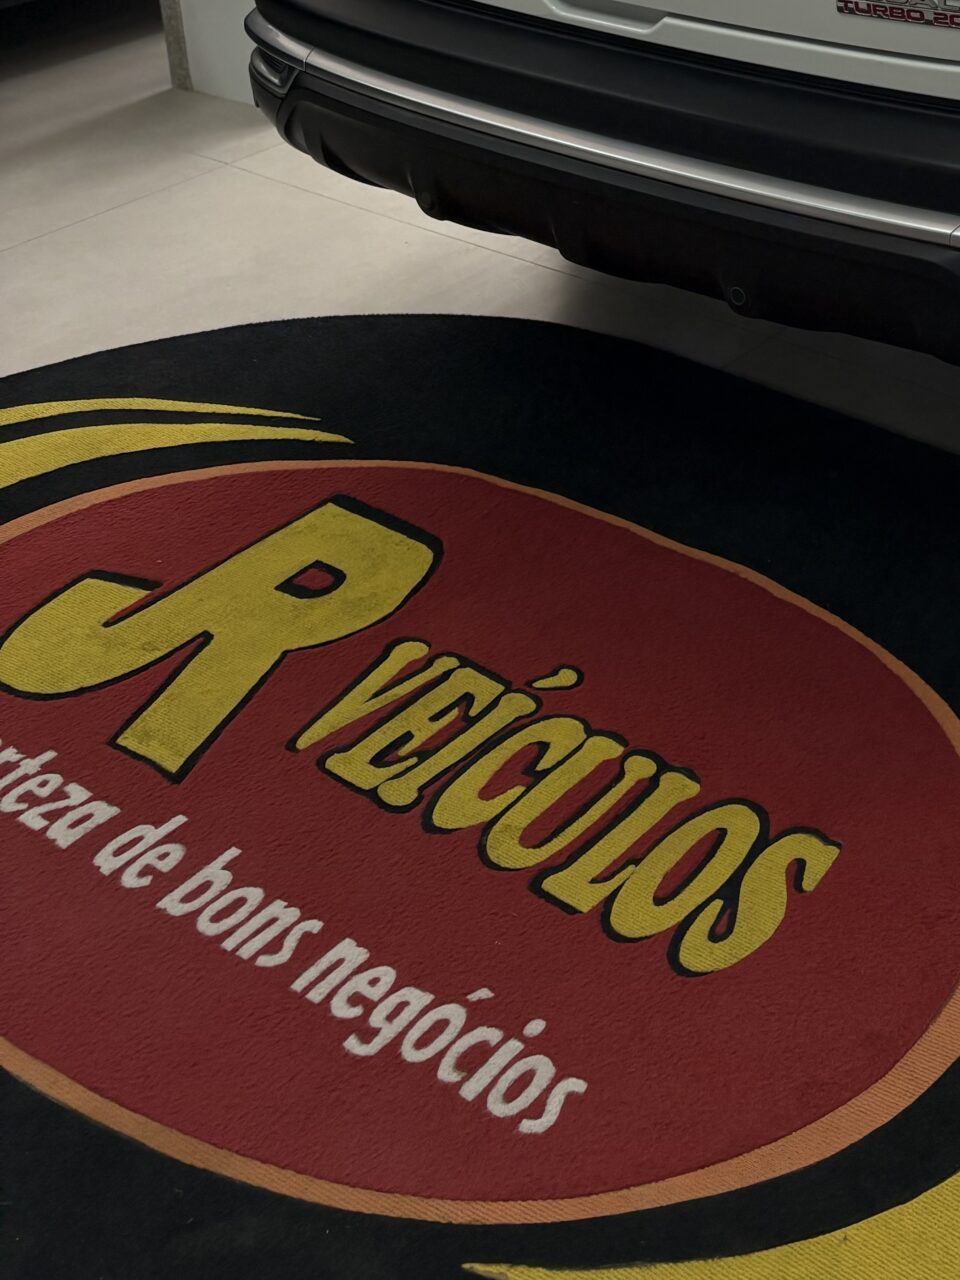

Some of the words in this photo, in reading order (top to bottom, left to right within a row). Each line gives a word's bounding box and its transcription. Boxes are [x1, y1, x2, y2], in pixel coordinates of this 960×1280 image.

[286, 638, 842, 978] VEÍCULOS
[92, 814, 188, 888] de
[155, 846, 323, 968] bons
[290, 937, 588, 1135] negócios
